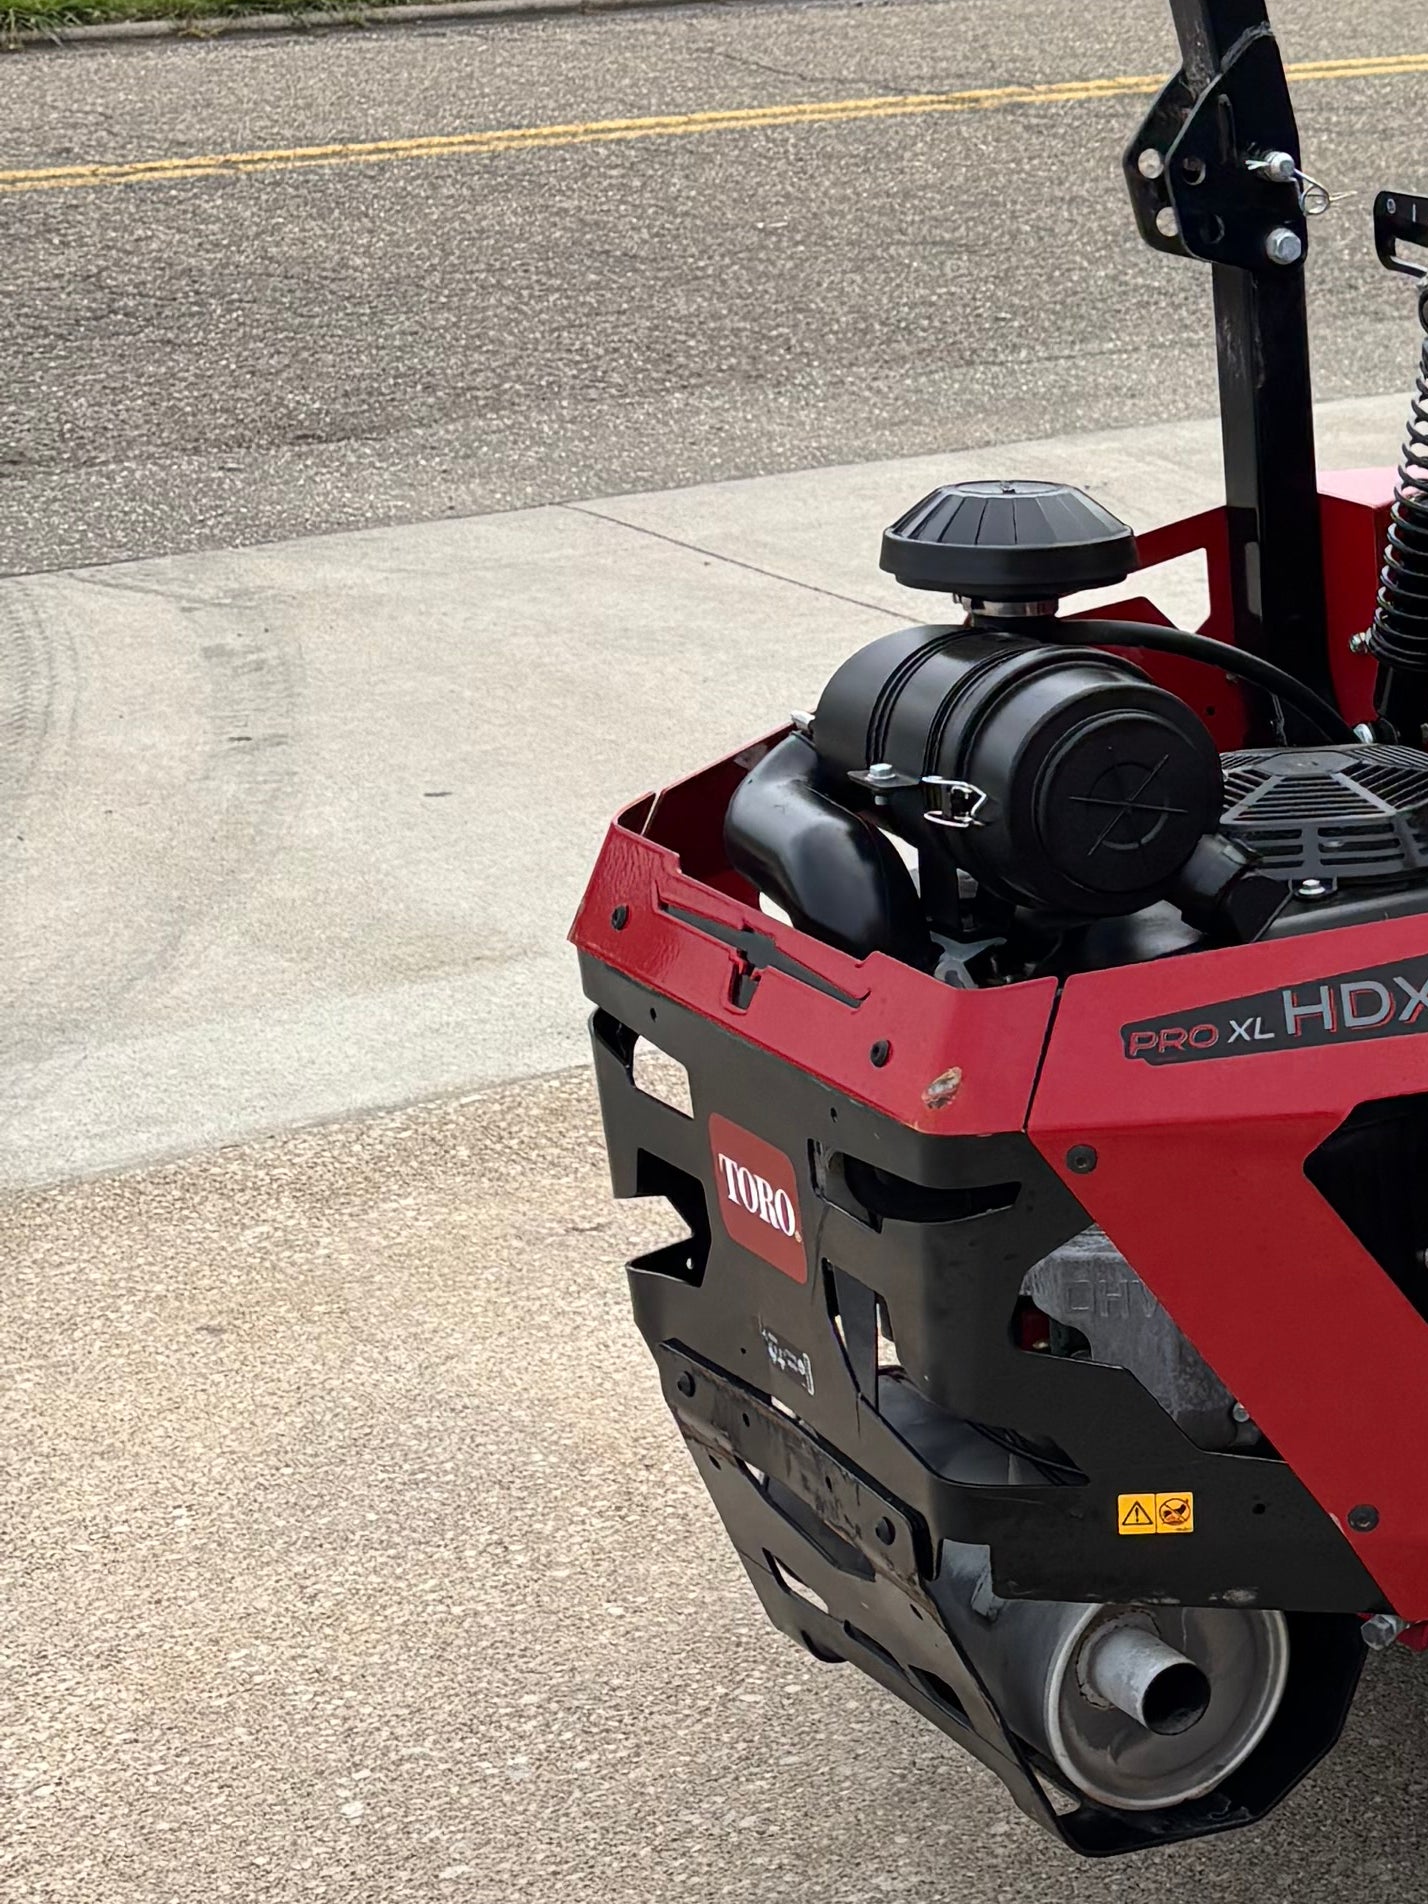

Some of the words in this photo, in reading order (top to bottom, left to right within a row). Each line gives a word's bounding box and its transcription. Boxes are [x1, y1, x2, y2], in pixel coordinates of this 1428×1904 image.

[1129, 1024, 1219, 1056] PRO
[1227, 1017, 1275, 1044] XL
[718, 1152, 796, 1238] TORO
